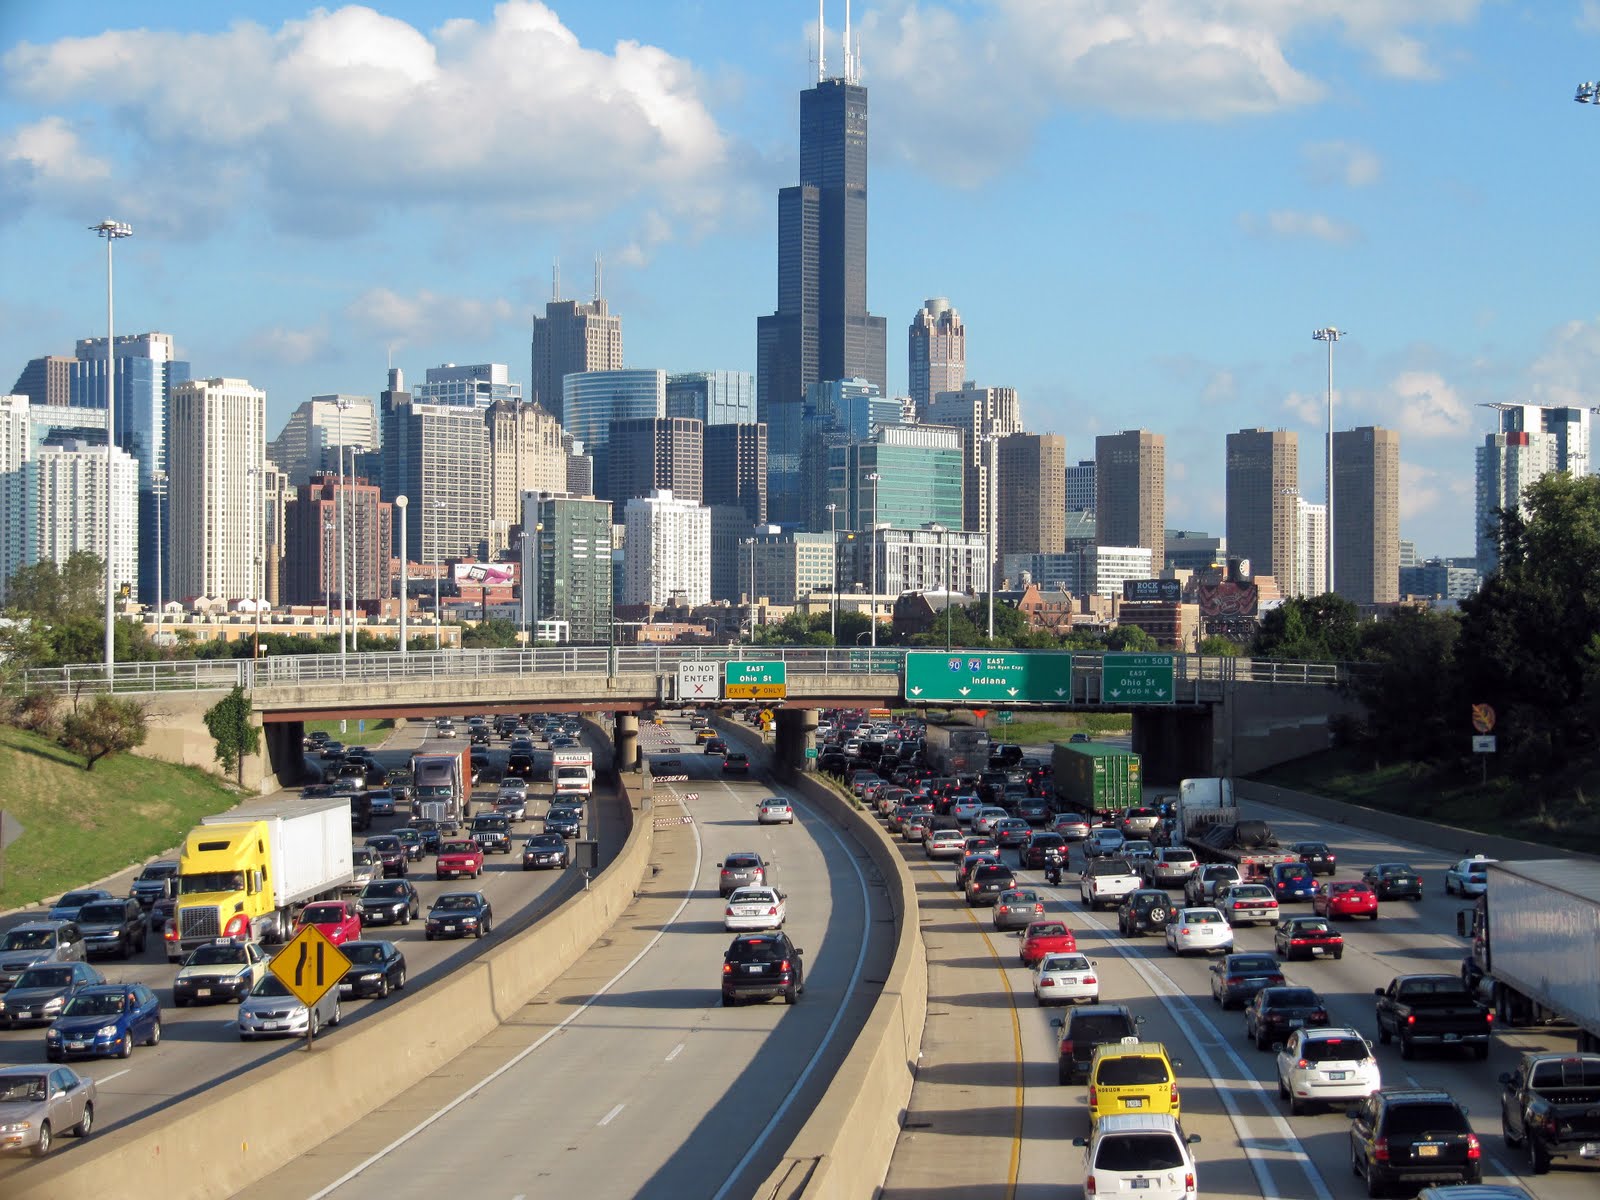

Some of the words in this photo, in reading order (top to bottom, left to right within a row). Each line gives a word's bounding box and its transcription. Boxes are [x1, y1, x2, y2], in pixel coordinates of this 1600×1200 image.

[949, 661, 960, 670] 90
[968, 661, 980, 670] 94
[972, 677, 1006, 685] Indiana
[1120, 678, 1141, 686] Ohio
[1145, 678, 1155, 686] St
